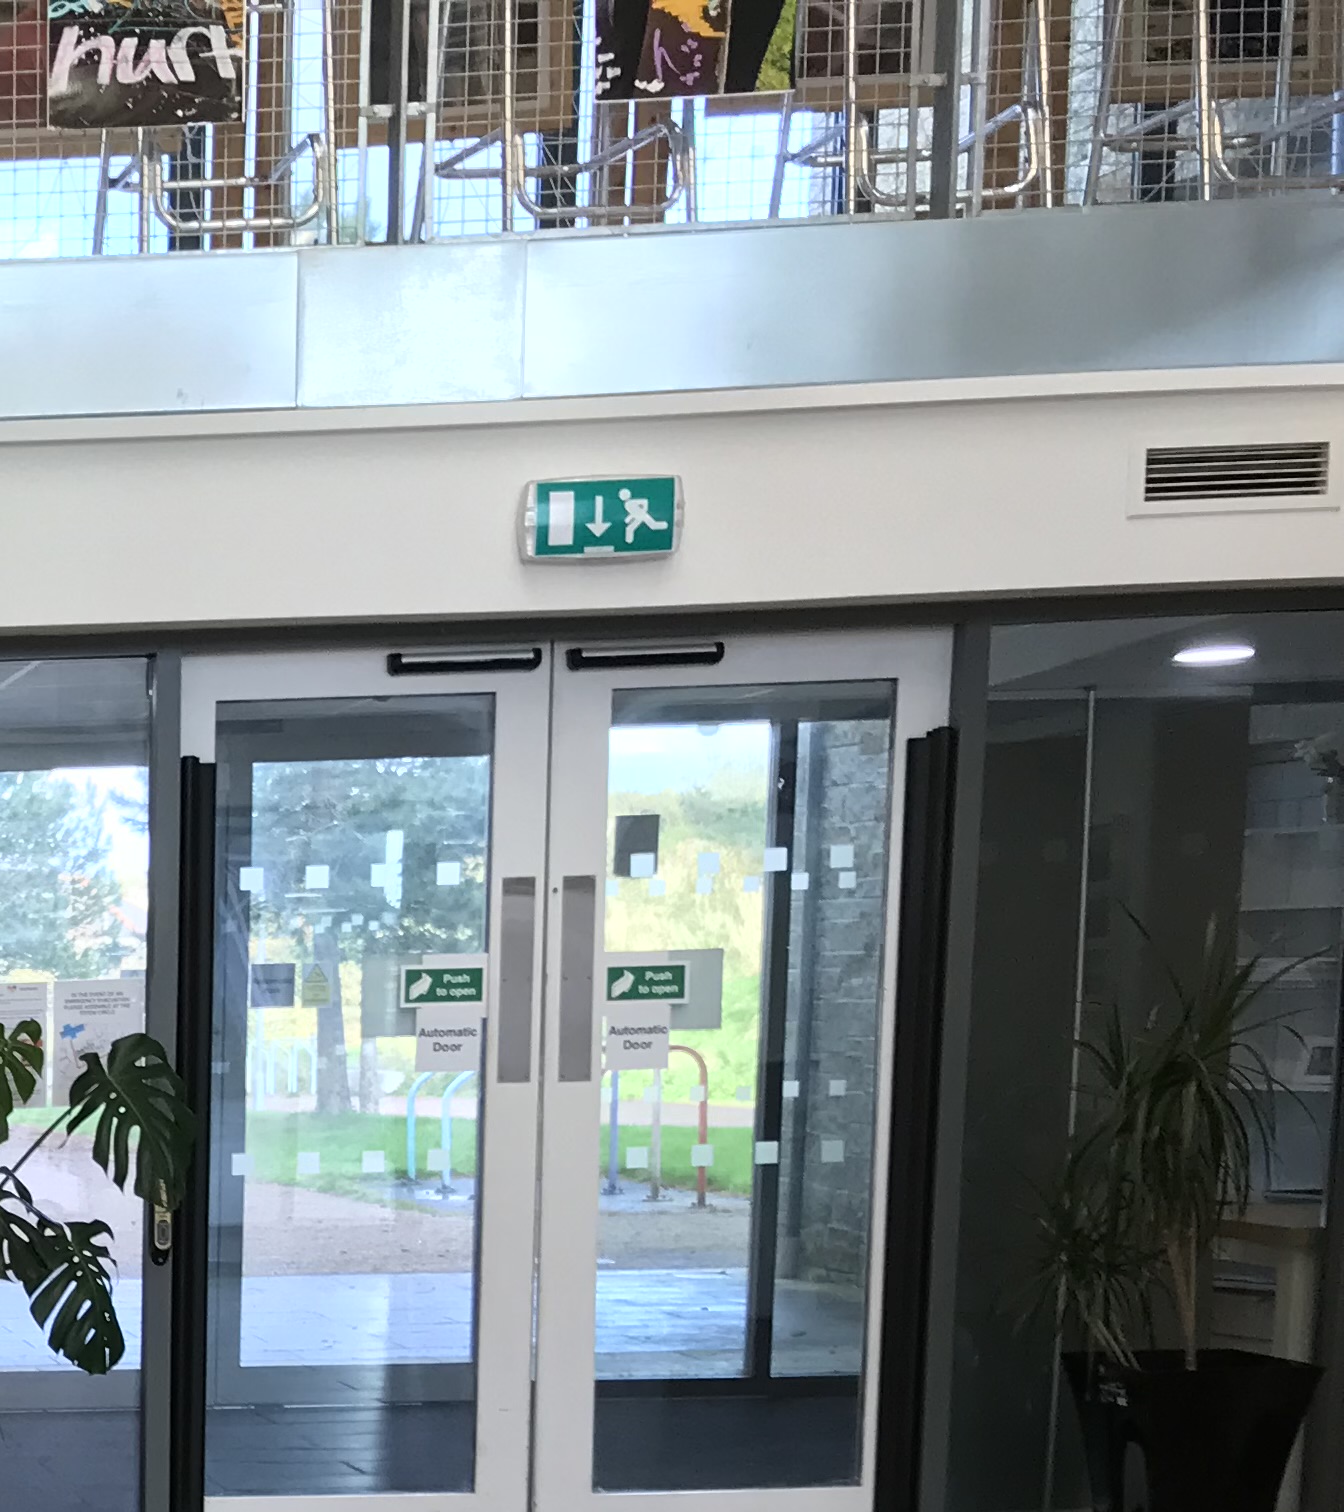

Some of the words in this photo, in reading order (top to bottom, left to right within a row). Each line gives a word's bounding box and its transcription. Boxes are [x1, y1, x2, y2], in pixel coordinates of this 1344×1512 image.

[443, 973, 470, 984] Push
[419, 1027, 477, 1038] Automatic
[609, 1025, 668, 1036] Automatic
[433, 1042, 463, 1052] Door
[623, 1040, 653, 1050] Door
